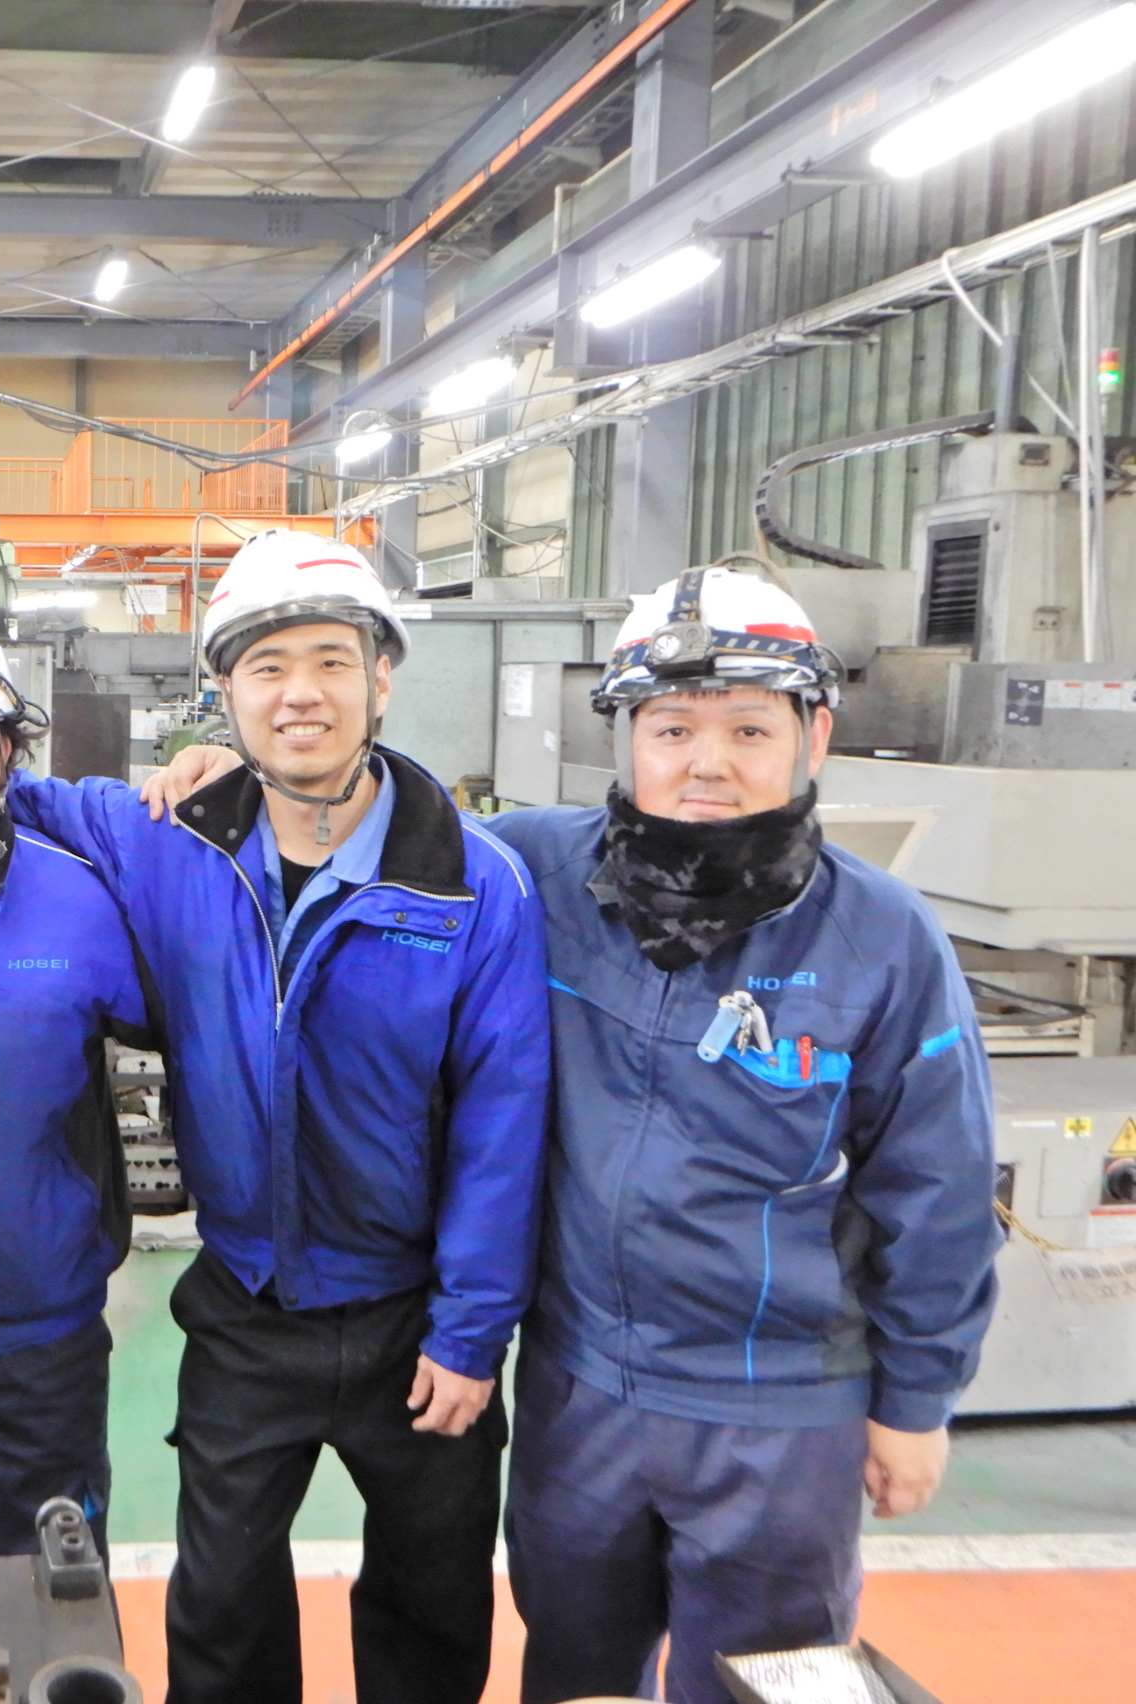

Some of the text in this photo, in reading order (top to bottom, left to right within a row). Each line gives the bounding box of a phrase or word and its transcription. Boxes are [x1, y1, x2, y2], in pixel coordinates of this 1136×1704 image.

[381, 930, 451, 953] HOSEI
[8, 959, 69, 970] HOSEI
[747, 972, 817, 991] HOEI
